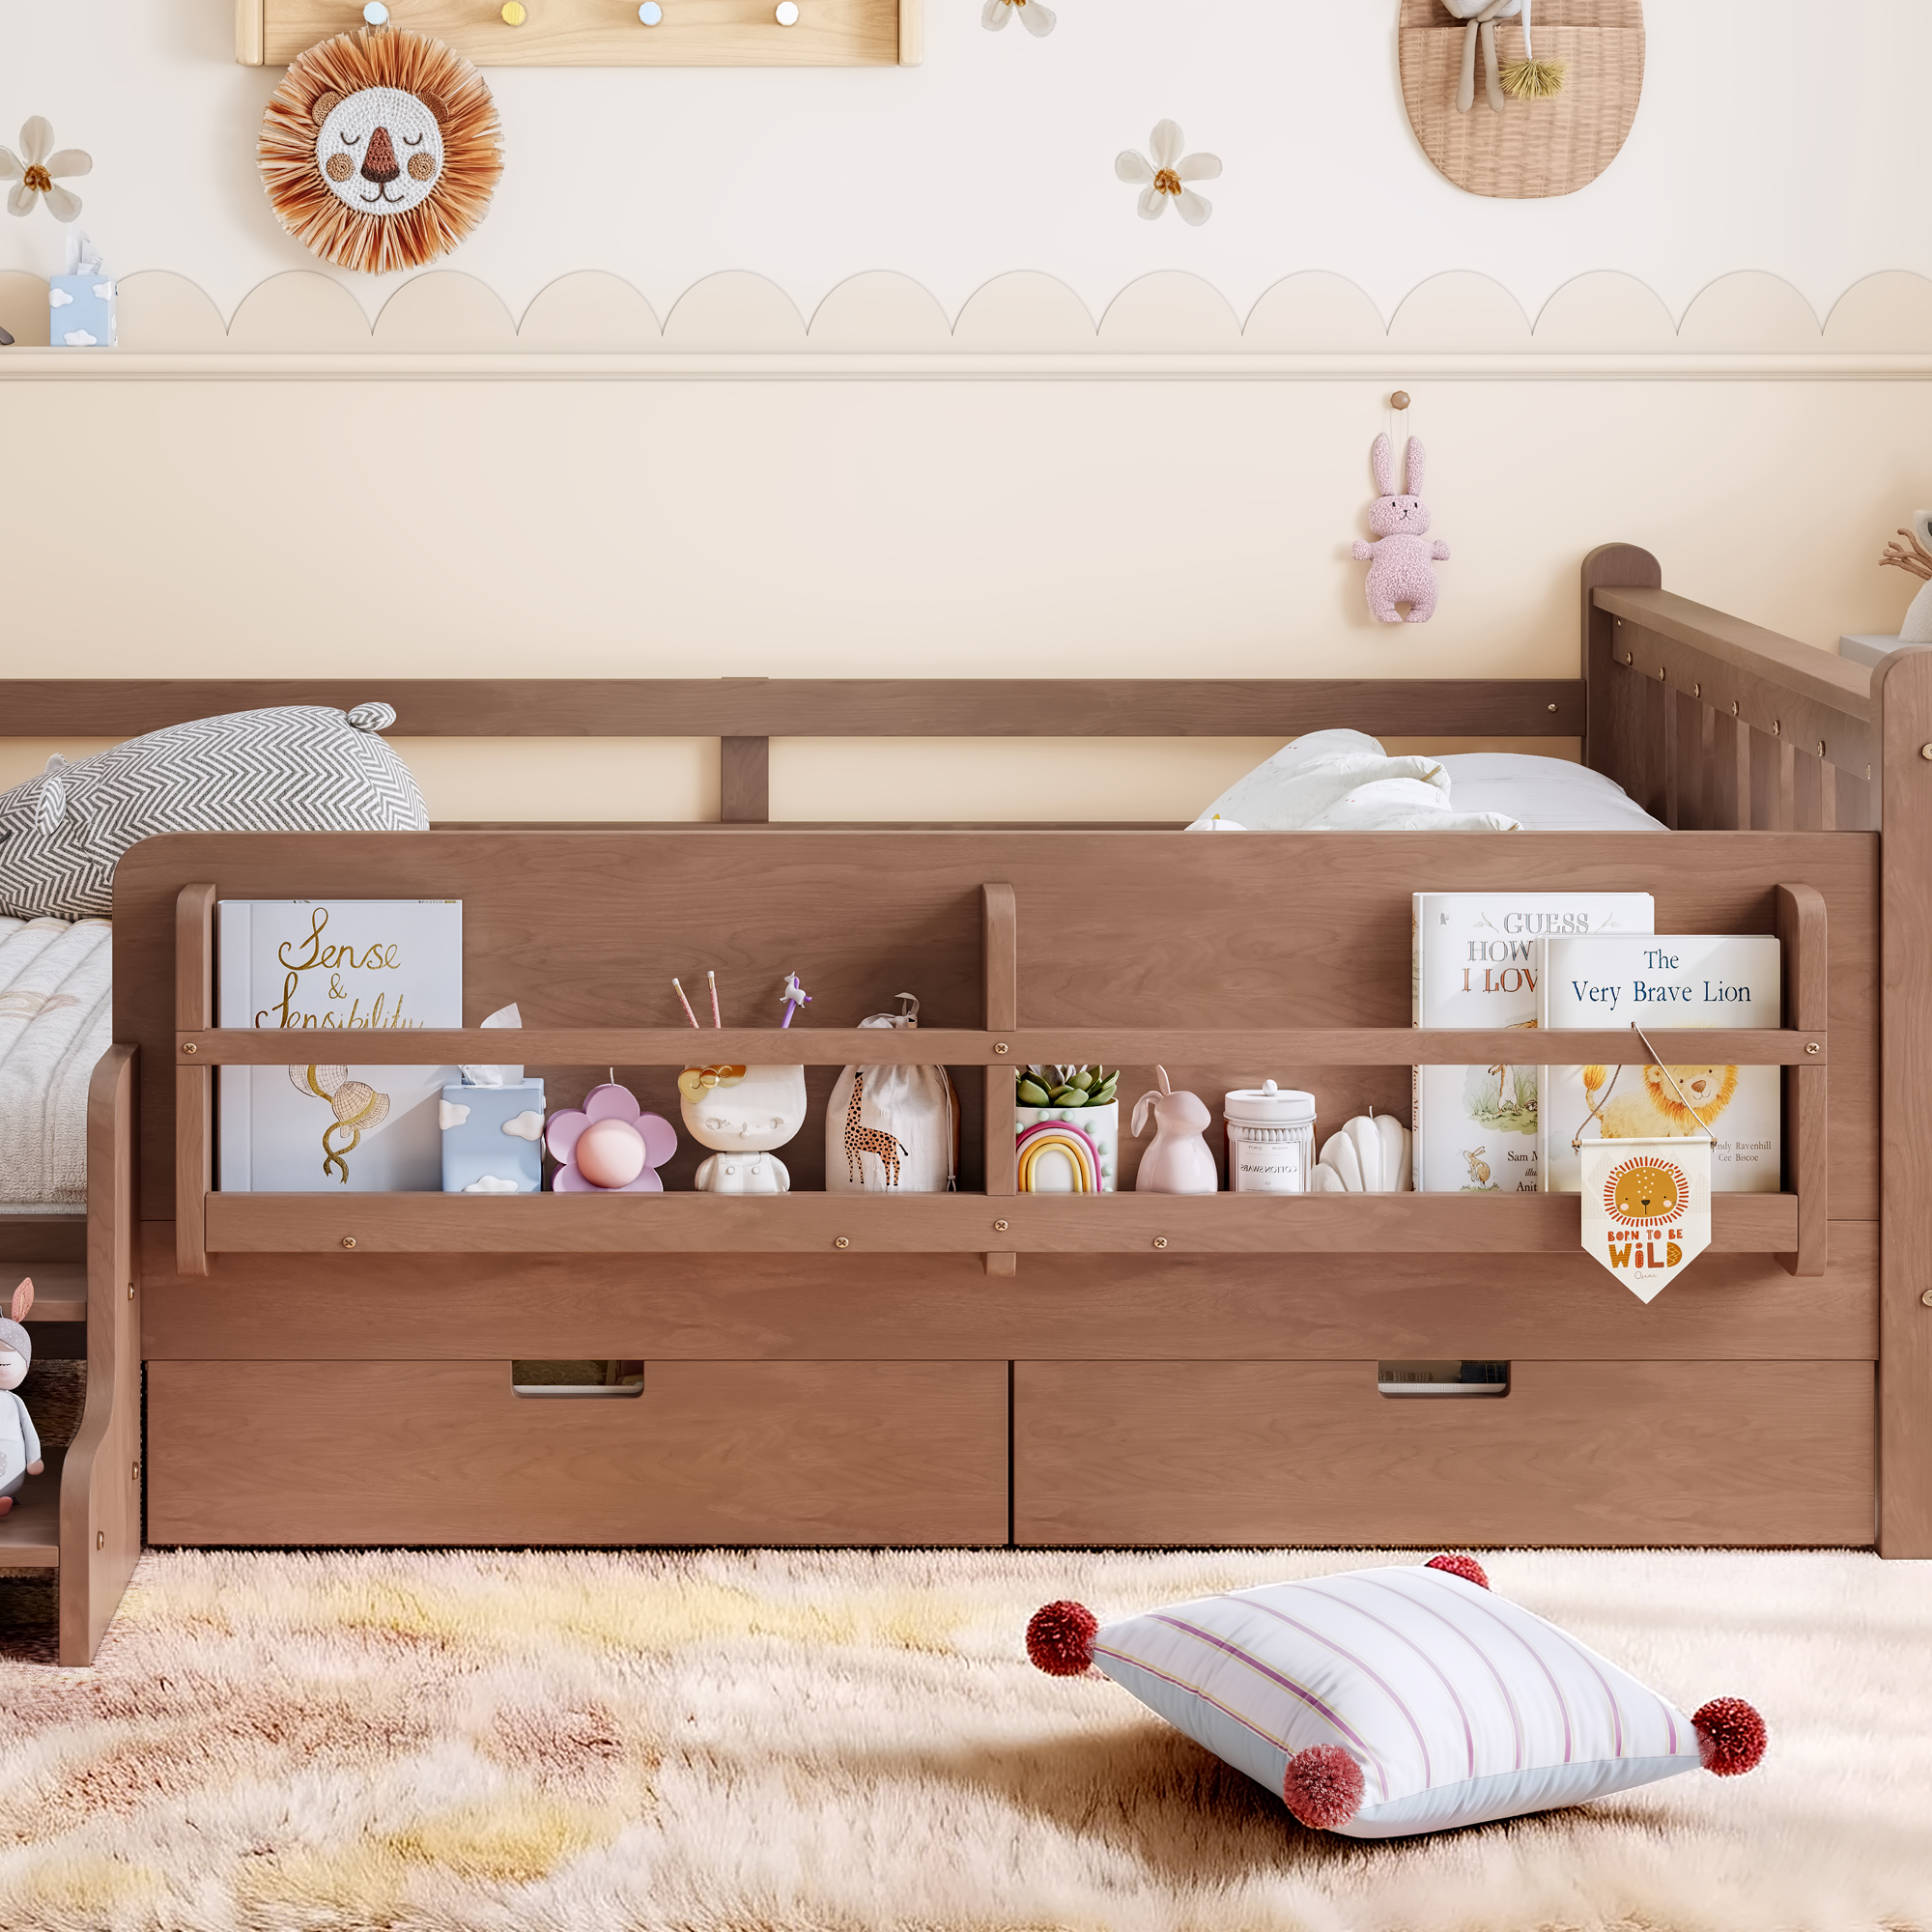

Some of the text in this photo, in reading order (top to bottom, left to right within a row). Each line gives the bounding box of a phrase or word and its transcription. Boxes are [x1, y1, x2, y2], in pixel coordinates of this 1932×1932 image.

[1503, 912, 1590, 935] GUESS
[278, 907, 401, 971] Sense
[1467, 940, 1534, 962] HOW
[1643, 949, 1680, 969] The
[328, 973, 347, 1000] &
[1462, 968, 1539, 994] I LOV
[1571, 980, 1751, 1011] Very Brave Lion
[1507, 1151, 1528, 1162] Sam
[1735, 1141, 1772, 1151] Ravenhill
[1735, 1153, 1759, 1162] Biscoe
[1516, 1180, 1538, 1192] Anit
[1607, 1228, 1683, 1242] BORN TO BE
